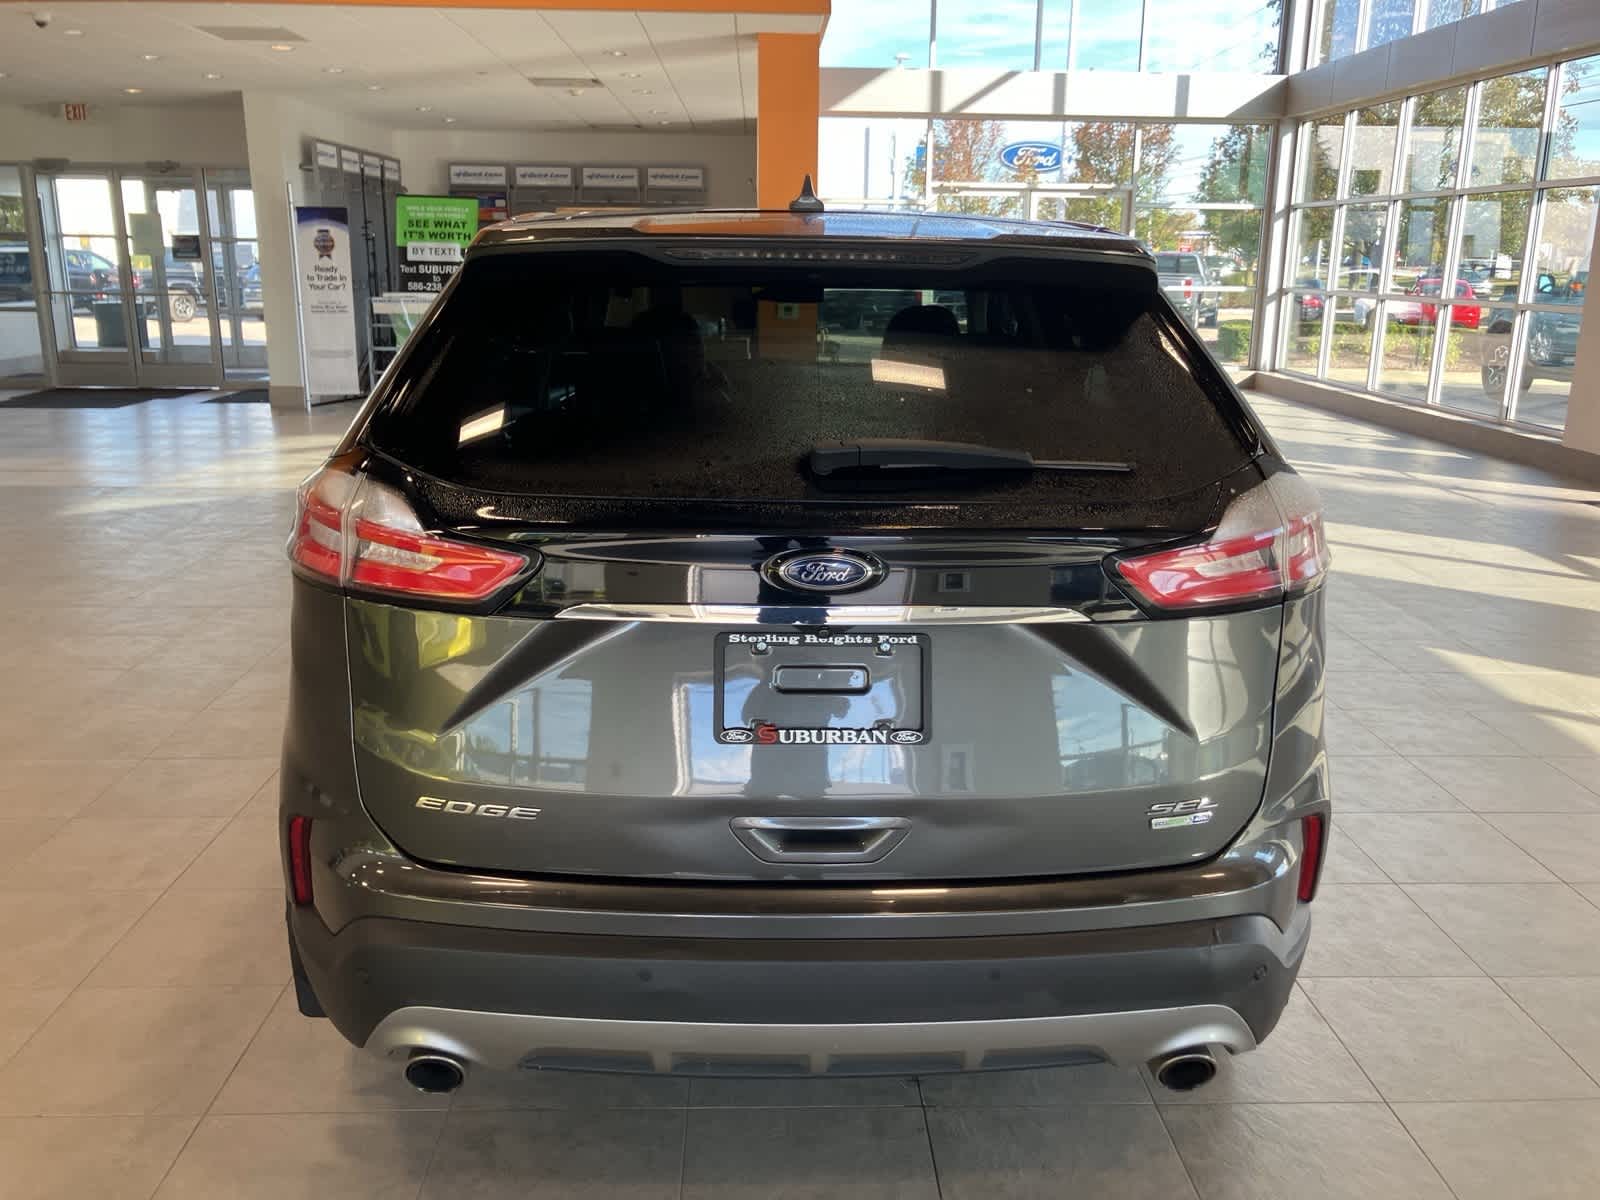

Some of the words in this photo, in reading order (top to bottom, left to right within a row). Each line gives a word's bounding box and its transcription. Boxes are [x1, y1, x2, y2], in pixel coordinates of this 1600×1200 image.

[65, 103, 87, 121] EXIT
[407, 219, 429, 228] SEE
[433, 220, 468, 229] WHAT
[403, 231, 424, 239] IT'S
[428, 232, 471, 241] WORTH
[412, 247, 425, 256] BY
[429, 247, 456, 256] TEXT!
[314, 265, 338, 274] Ready
[400, 265, 417, 273] Text
[309, 283, 326, 291] Your
[328, 283, 346, 291] Car?
[801, 562, 851, 582] Ford
[728, 634, 800, 645] Sterling
[804, 634, 874, 645] Heights
[877, 634, 918, 644] Ford
[758, 724, 888, 744] SUBURBAN
[415, 796, 542, 820] EDGE
[1147, 797, 1219, 816] SEL
